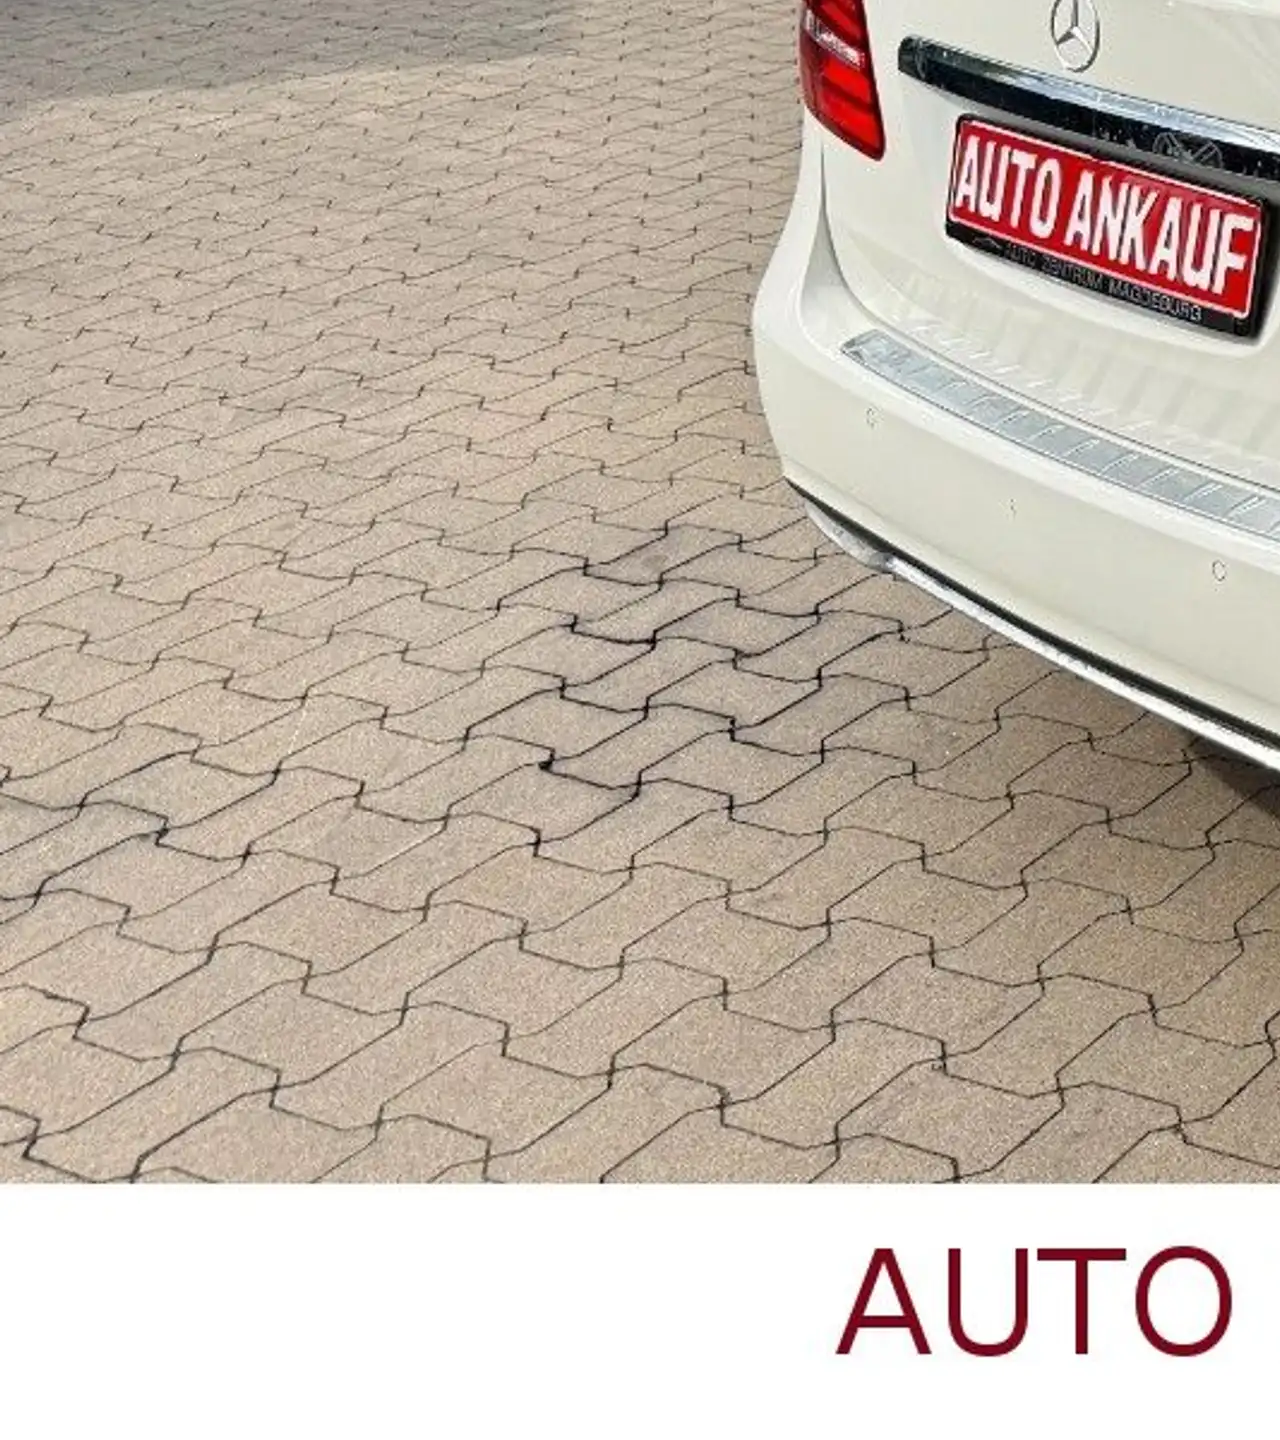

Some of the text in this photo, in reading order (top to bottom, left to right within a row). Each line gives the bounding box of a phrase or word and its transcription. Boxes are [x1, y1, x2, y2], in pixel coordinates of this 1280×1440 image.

[955, 135, 1254, 296] AUTO ANKAUF
[1041, 254, 1103, 290] ZENTRUM
[1108, 279, 1202, 322] MAGDEBURG
